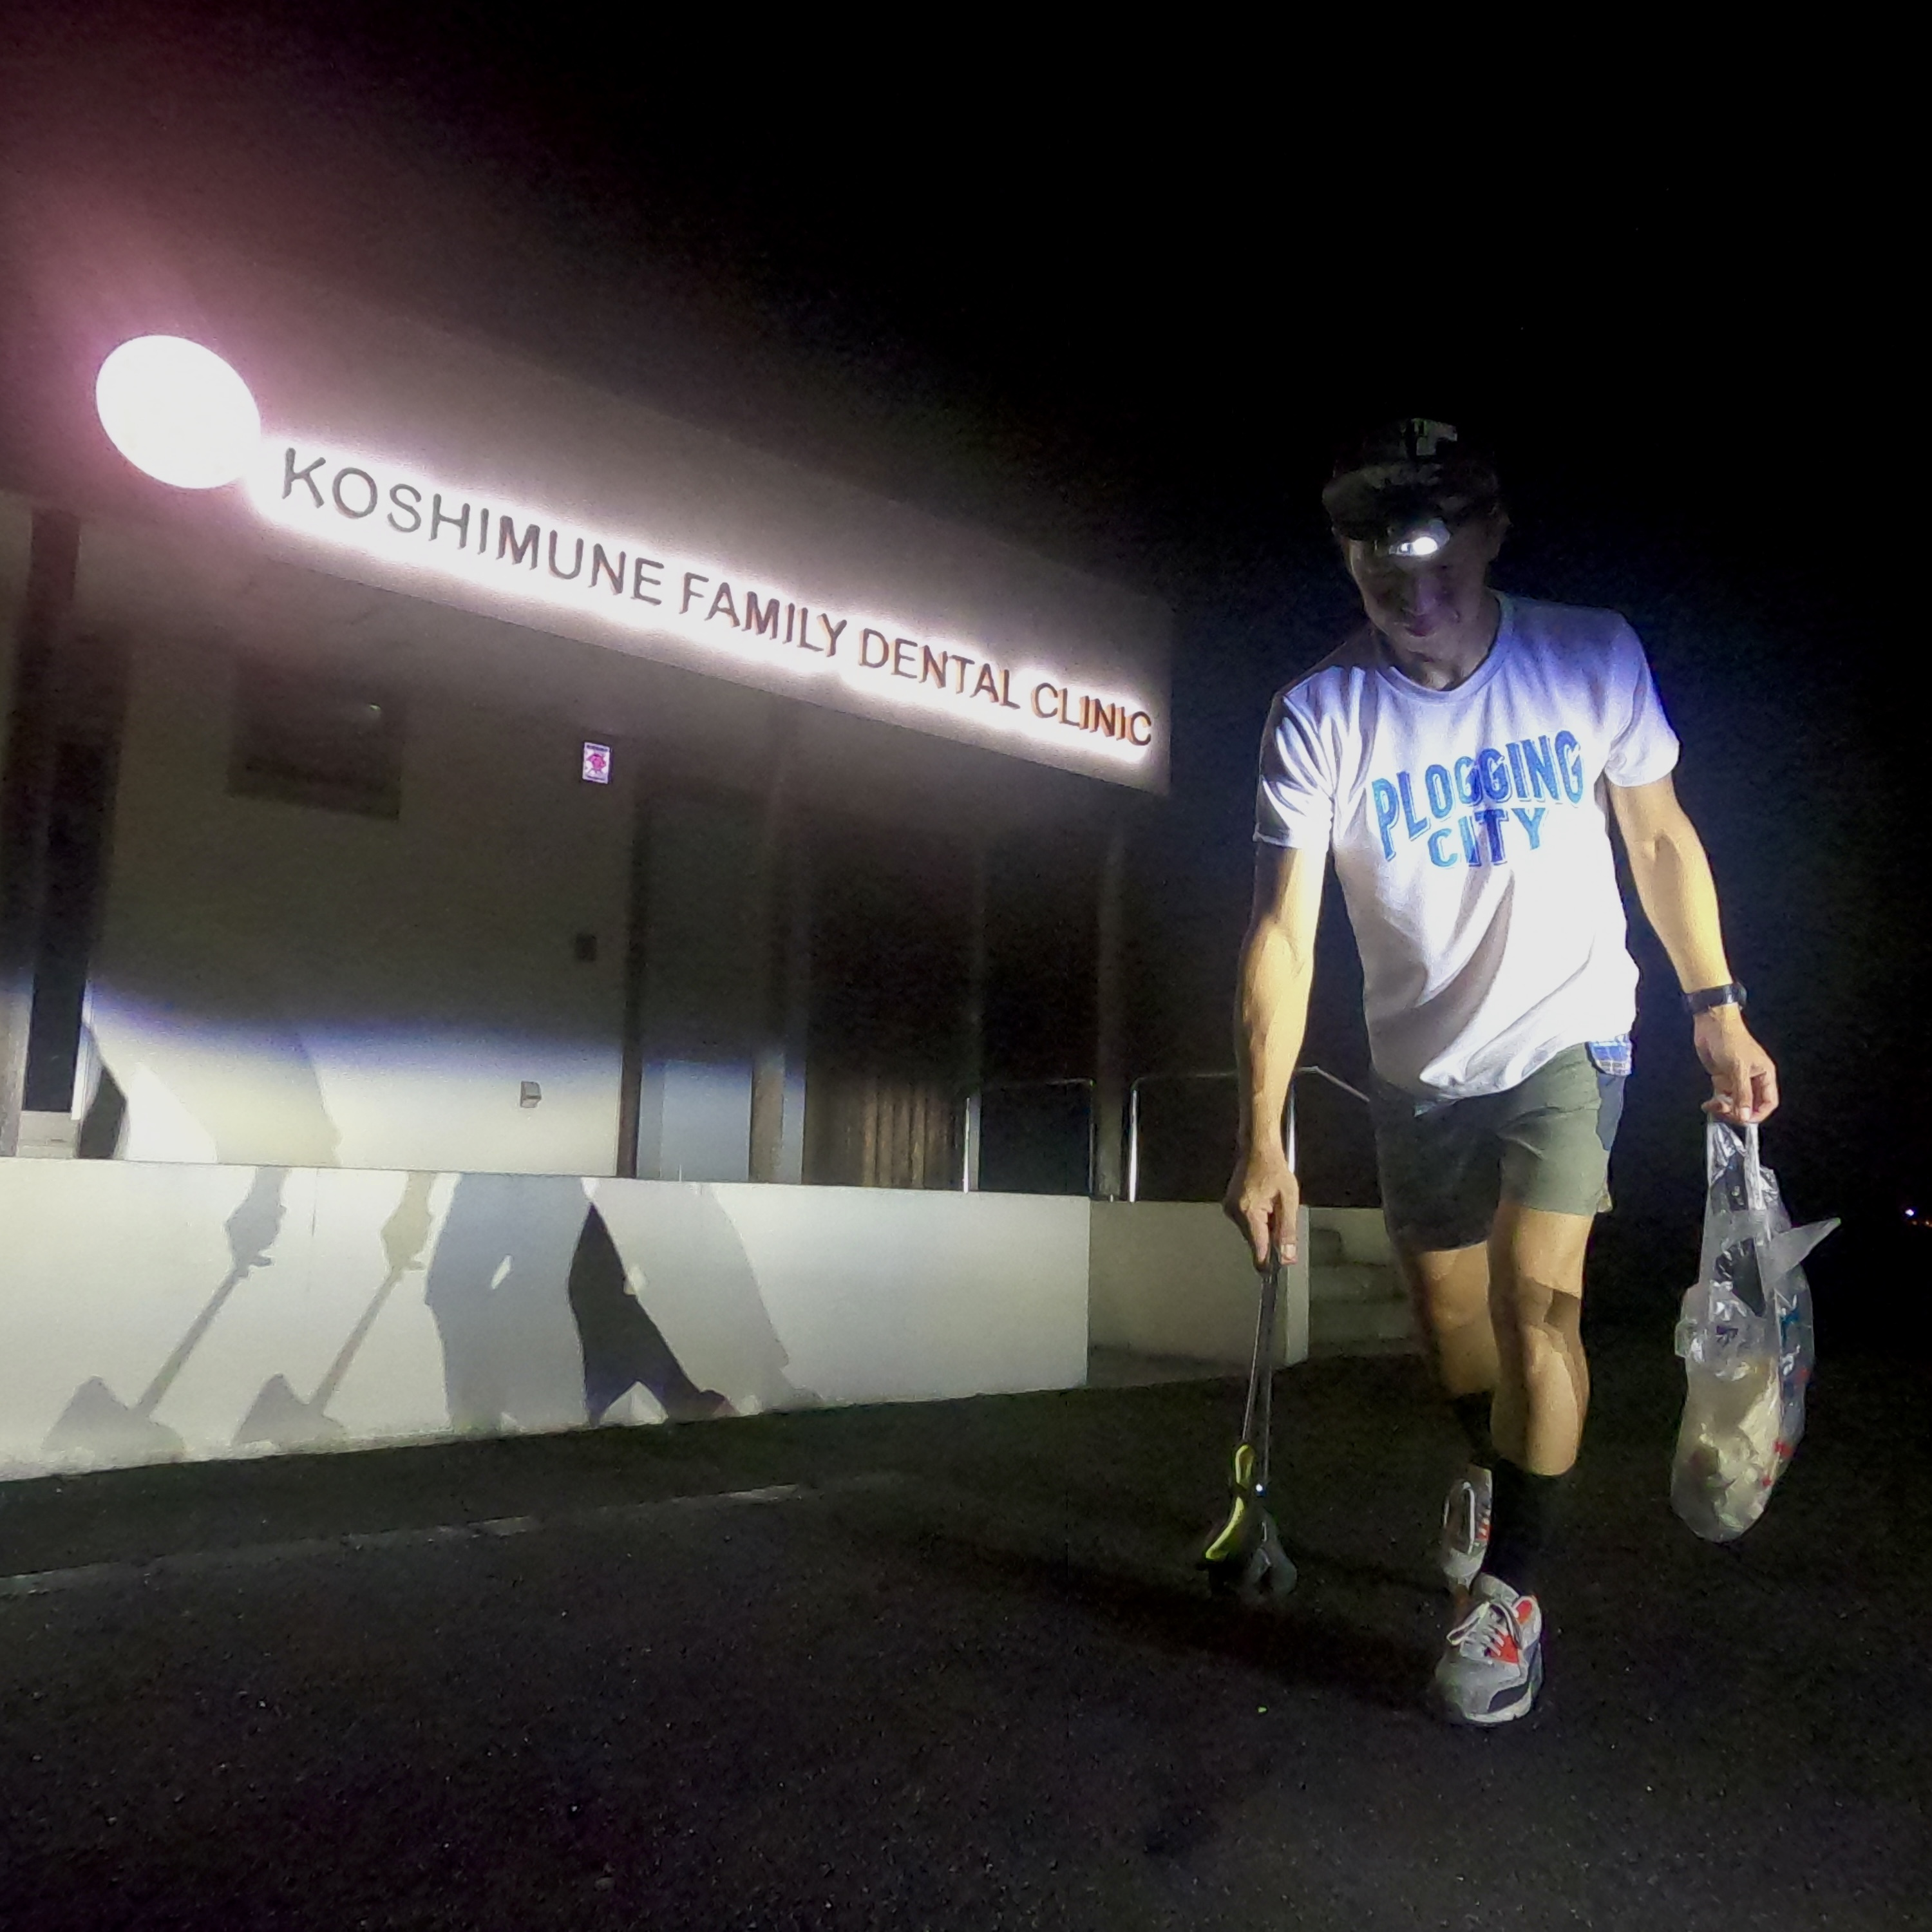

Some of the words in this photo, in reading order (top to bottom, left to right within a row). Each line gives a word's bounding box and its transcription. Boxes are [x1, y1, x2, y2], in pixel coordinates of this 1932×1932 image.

[281, 448, 665, 605] KOSHIMUNE
[679, 572, 848, 658] FAMILY
[858, 628, 1020, 710] DENTAL
[1031, 682, 1152, 746] CLINIC
[1372, 730, 1584, 862] PLOGGING
[1427, 807, 1548, 868] CITY
